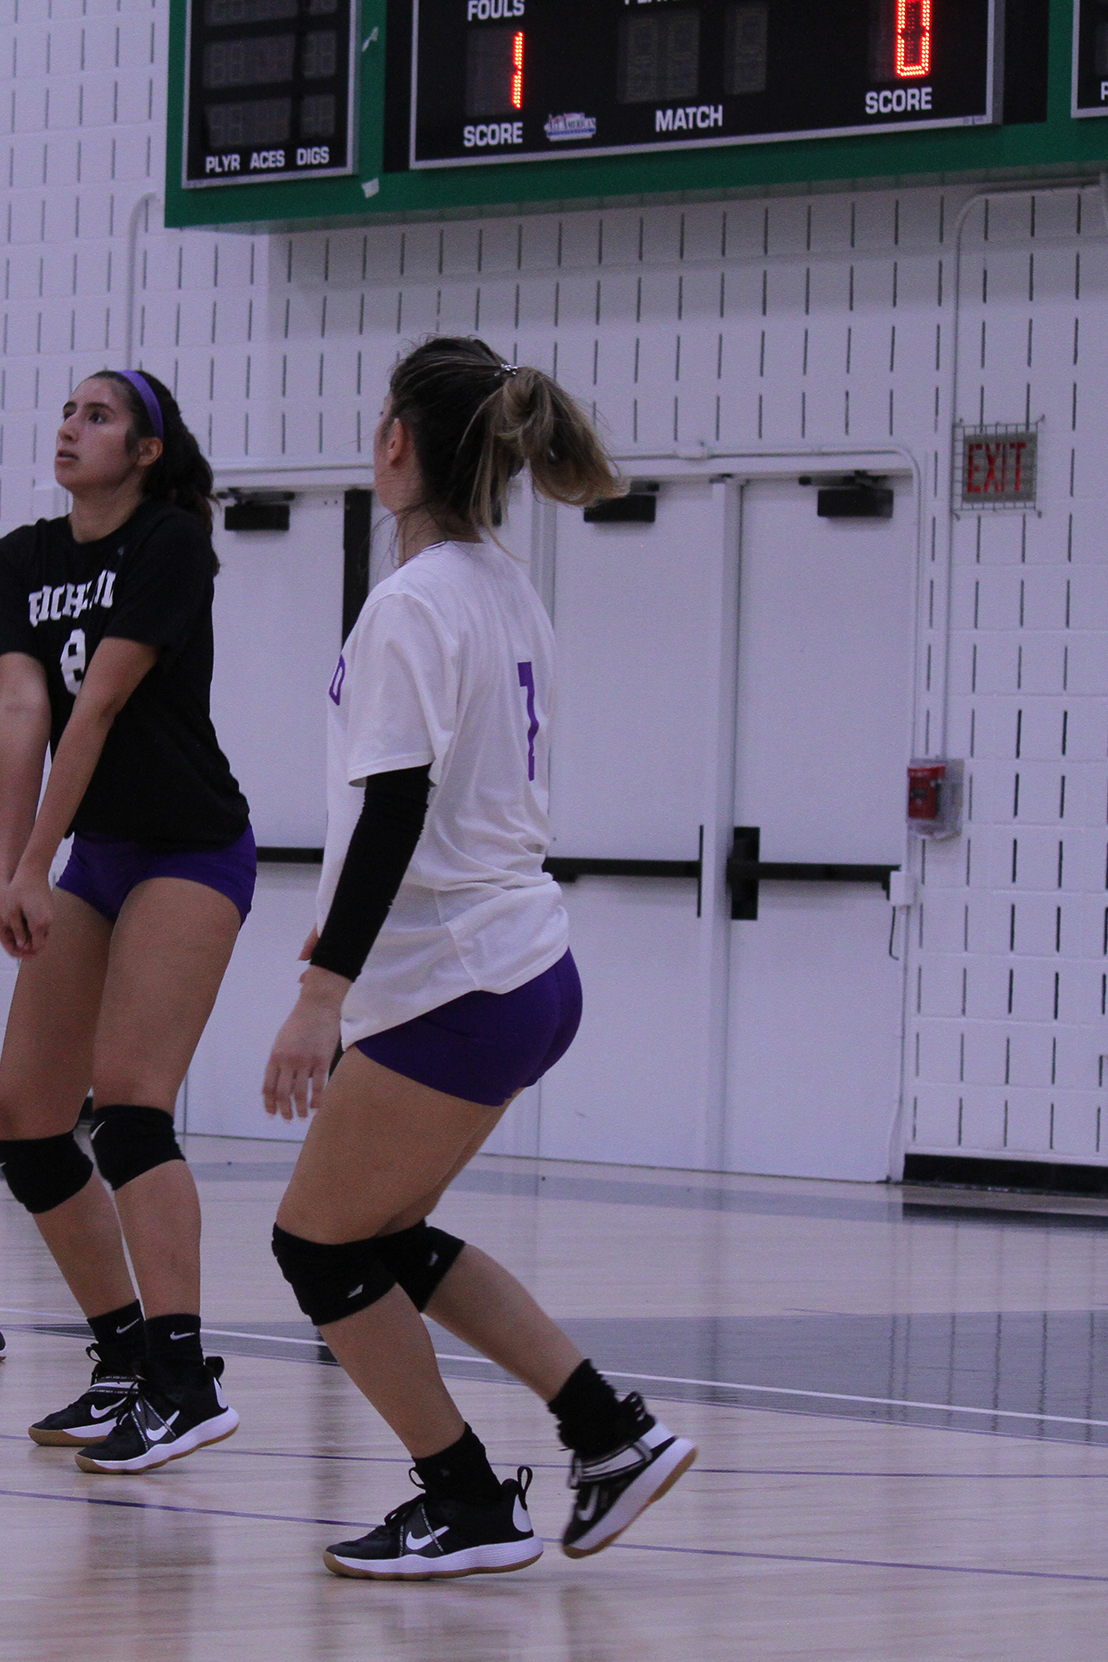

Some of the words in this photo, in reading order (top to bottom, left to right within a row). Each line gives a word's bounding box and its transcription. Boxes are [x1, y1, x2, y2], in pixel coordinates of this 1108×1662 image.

[467, 0, 525, 21] FOULS
[511, 31, 525, 109] 1
[865, 87, 932, 114] SCORE
[655, 104, 723, 132] MATCH
[463, 122, 523, 147] SCORE
[205, 154, 241, 173] PLYR
[250, 150, 286, 170] ACES
[296, 145, 330, 165] DIGS
[967, 442, 1026, 493] EXIT
